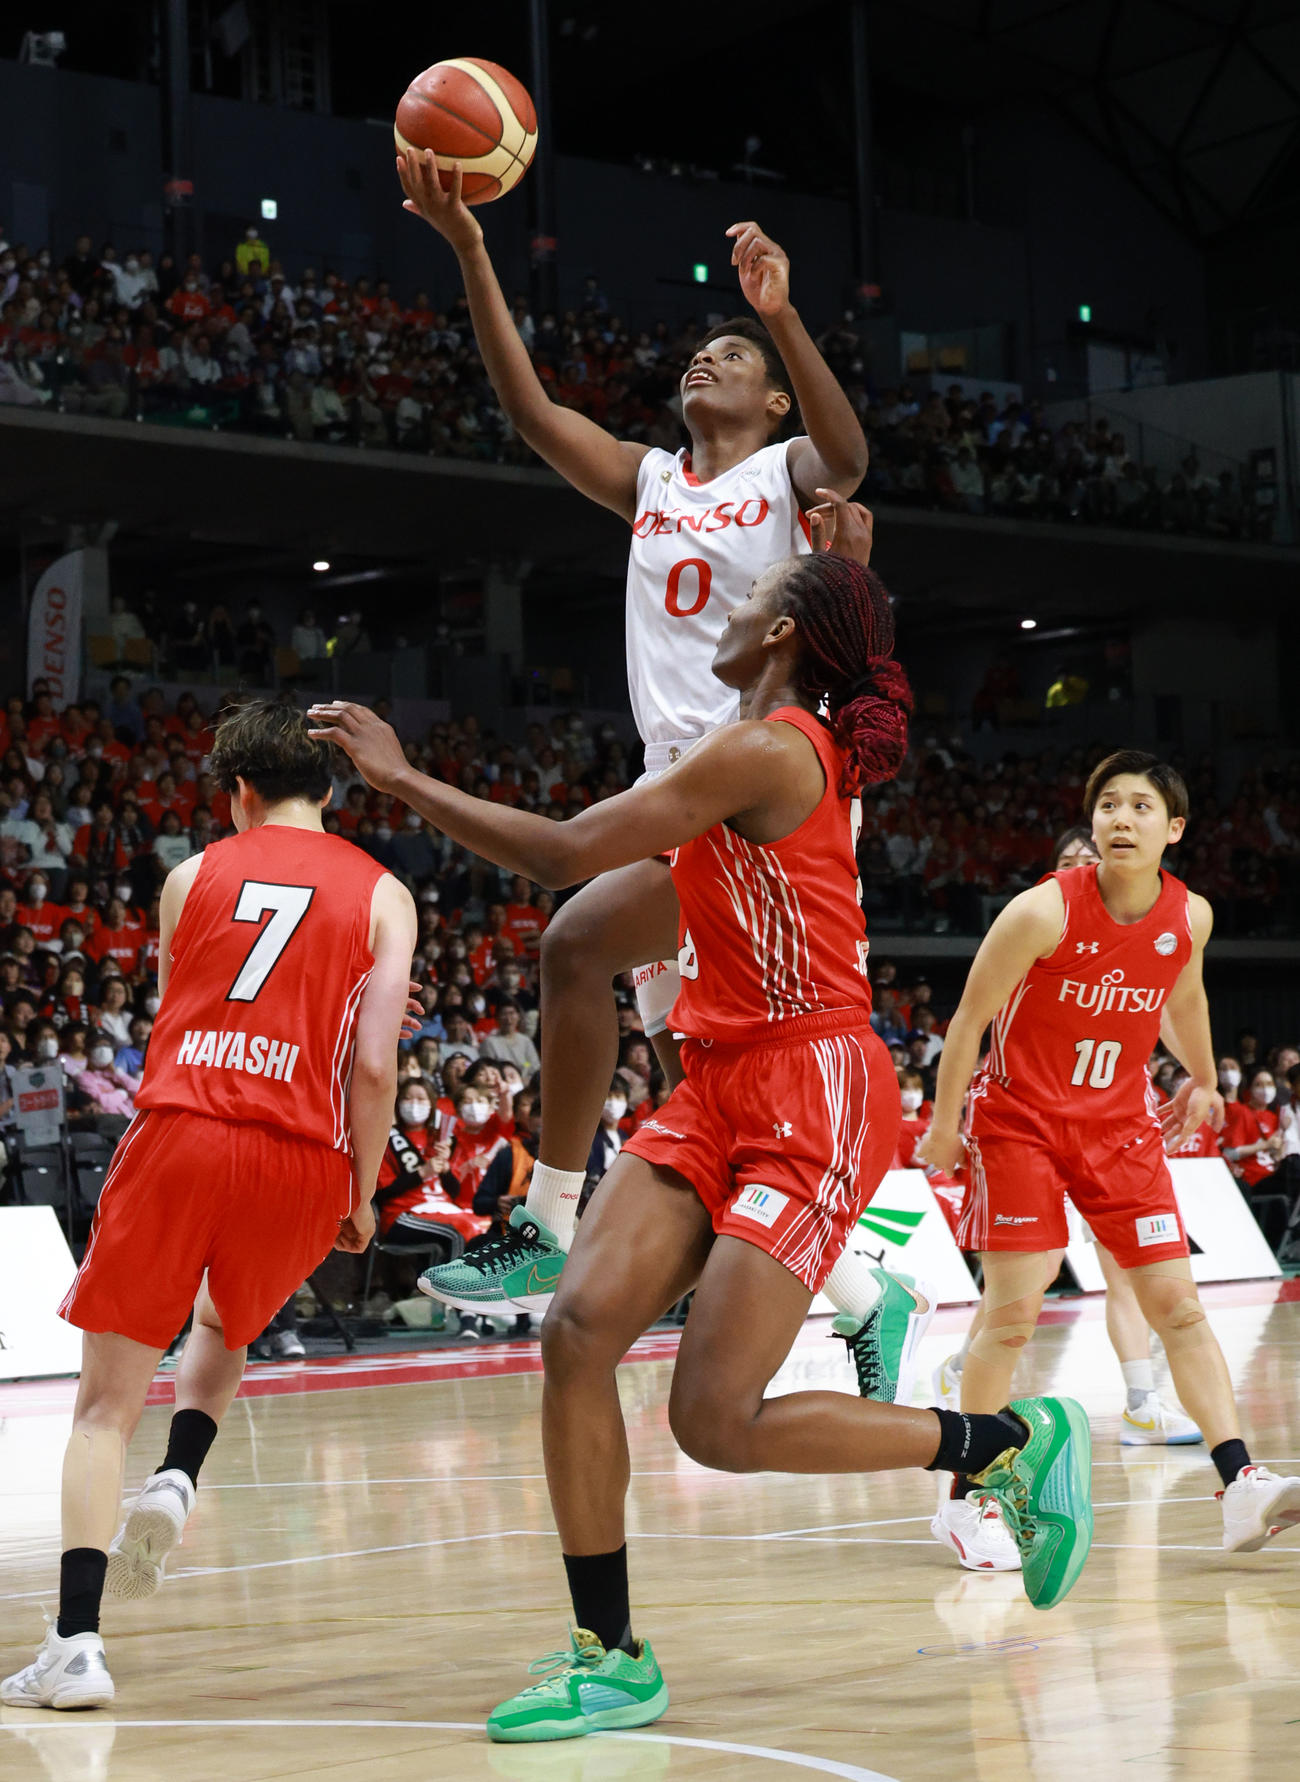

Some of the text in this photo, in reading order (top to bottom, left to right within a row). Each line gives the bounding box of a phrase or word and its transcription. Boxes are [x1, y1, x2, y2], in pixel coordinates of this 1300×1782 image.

[633, 498, 769, 539] DENSO
[665, 558, 712, 617] 0
[43, 587, 67, 700] DENSO
[224, 879, 317, 1003] 7
[1058, 968, 1165, 1017] FUJITSU
[176, 1030, 300, 1083] HAYASHI
[1070, 1038, 1122, 1089] 10
[560, 1192, 579, 1200] DENS
